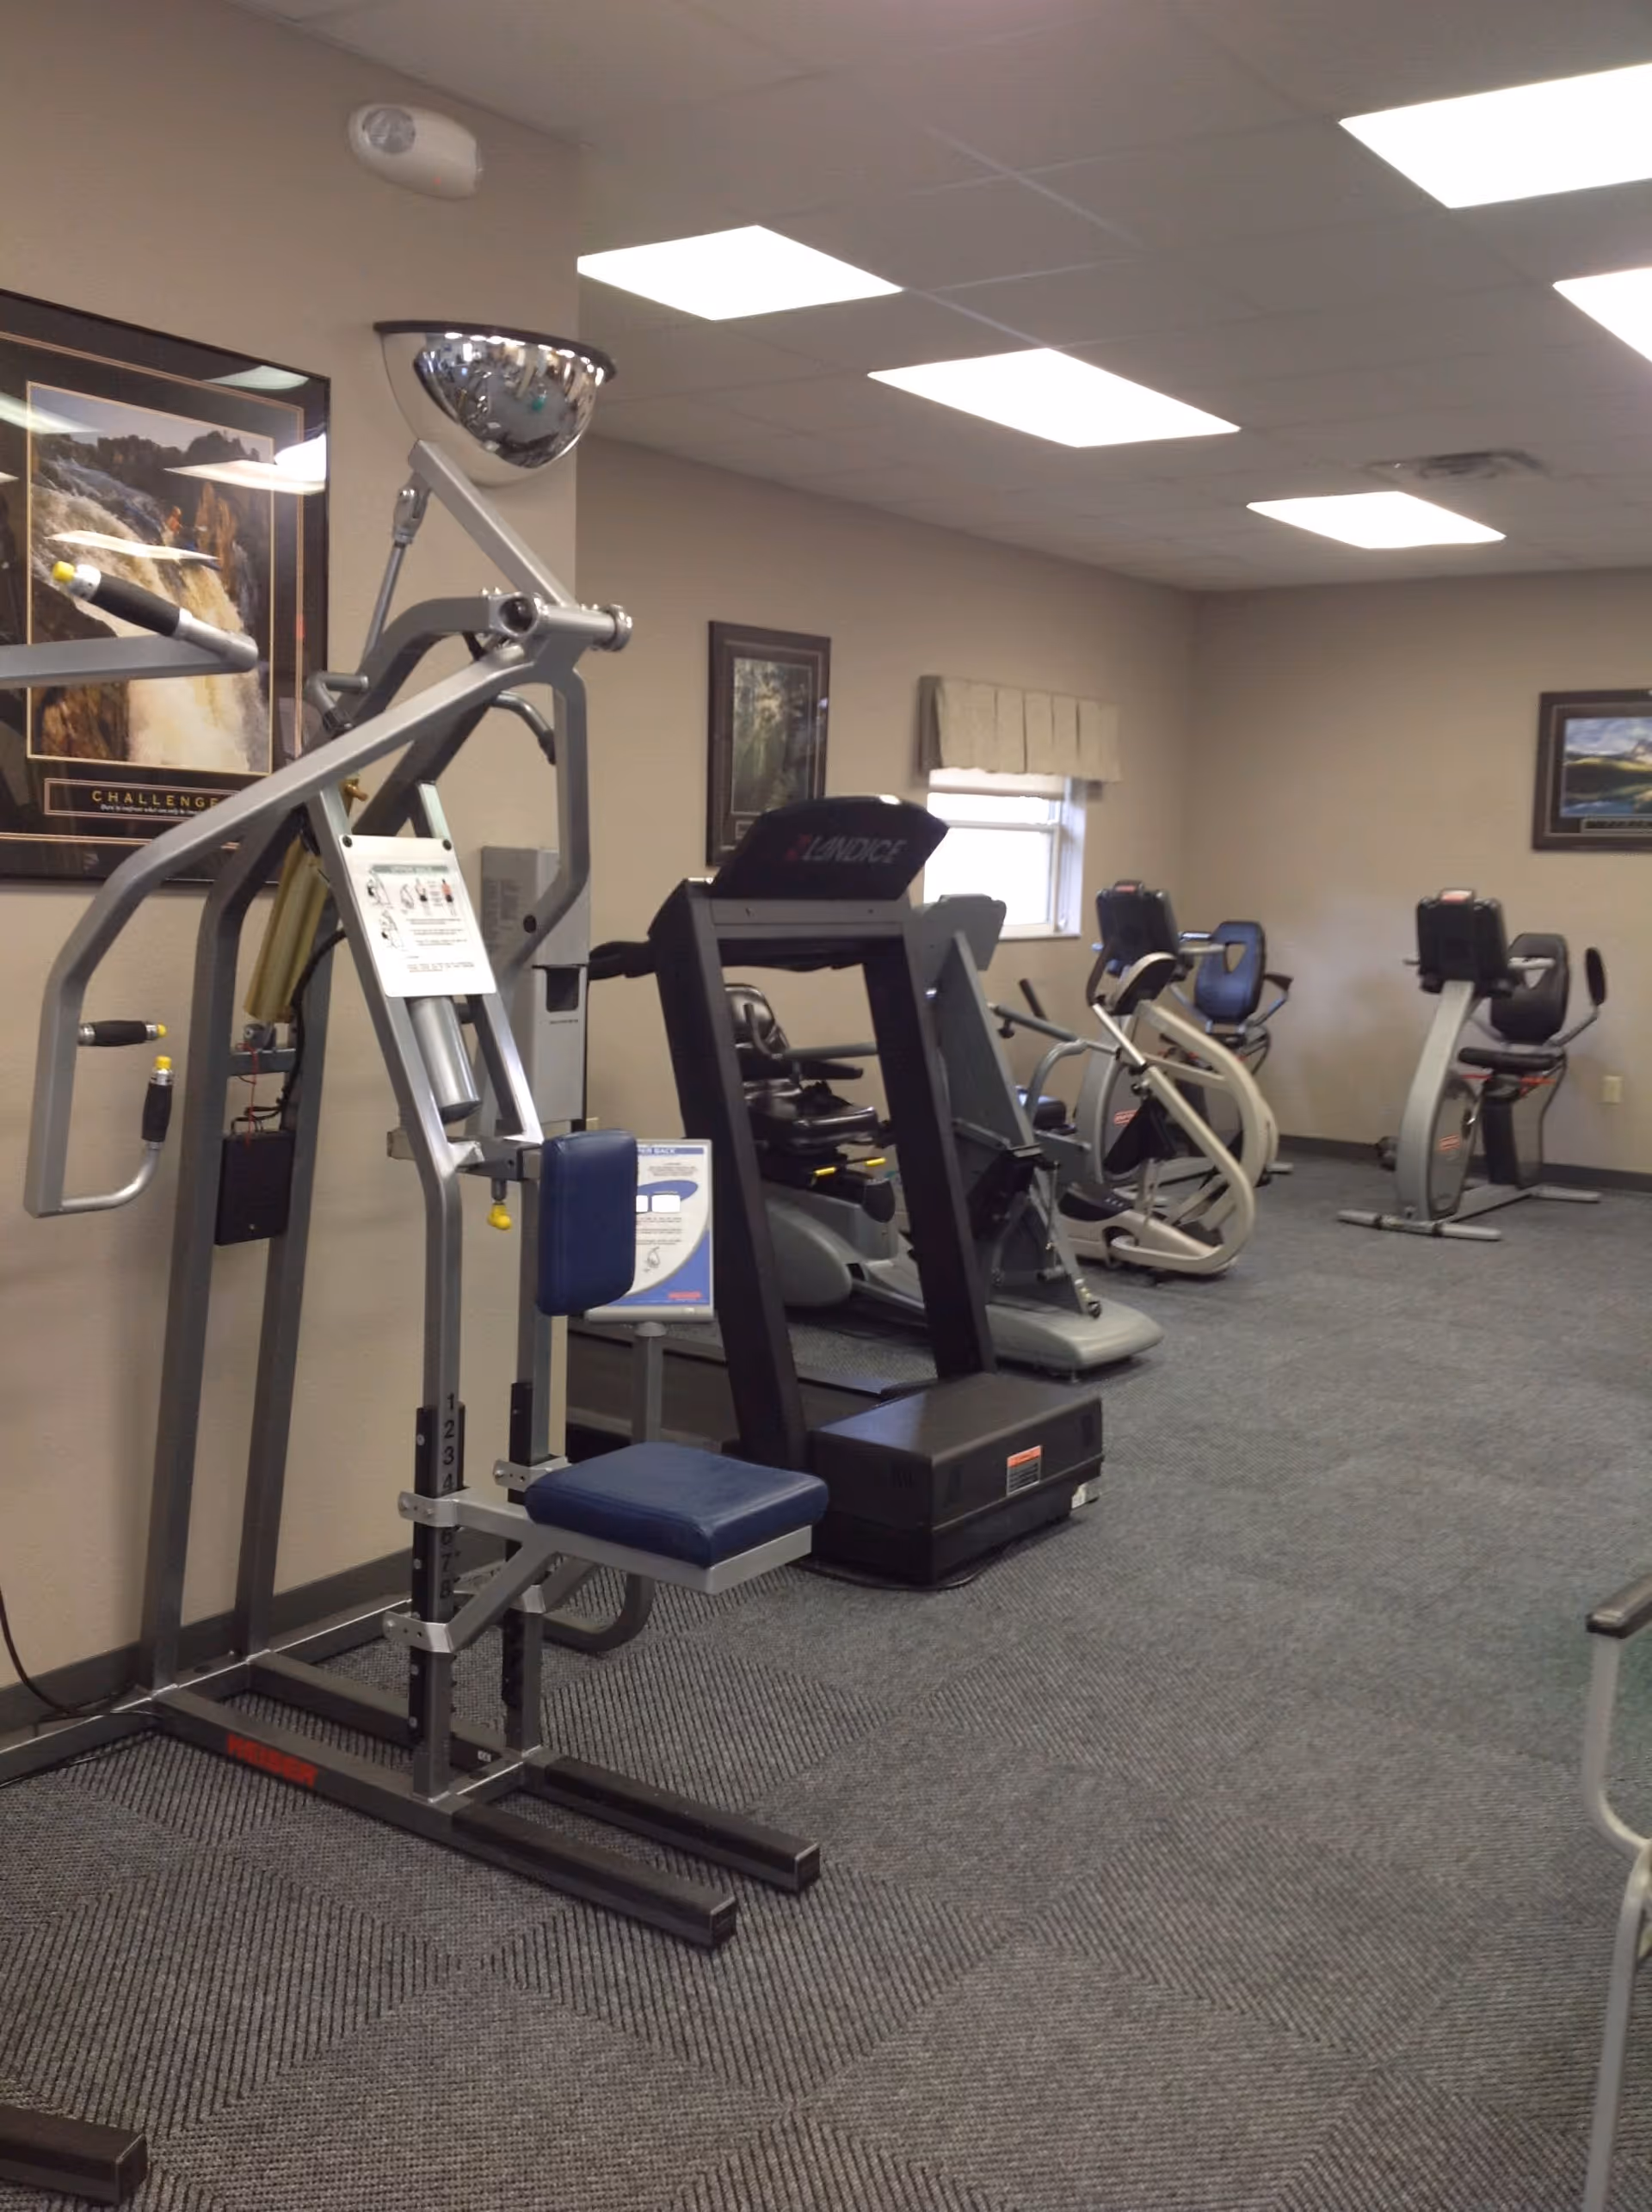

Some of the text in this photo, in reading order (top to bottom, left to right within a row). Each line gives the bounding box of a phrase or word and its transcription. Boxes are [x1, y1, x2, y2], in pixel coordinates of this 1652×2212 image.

[802, 835, 906, 863] LANDICE
[447, 1393, 455, 1410] 1
[444, 1420, 455, 1439] 2
[442, 1446, 454, 1465] 3
[442, 1473, 454, 1491] 4
[441, 1552, 453, 1572] 7
